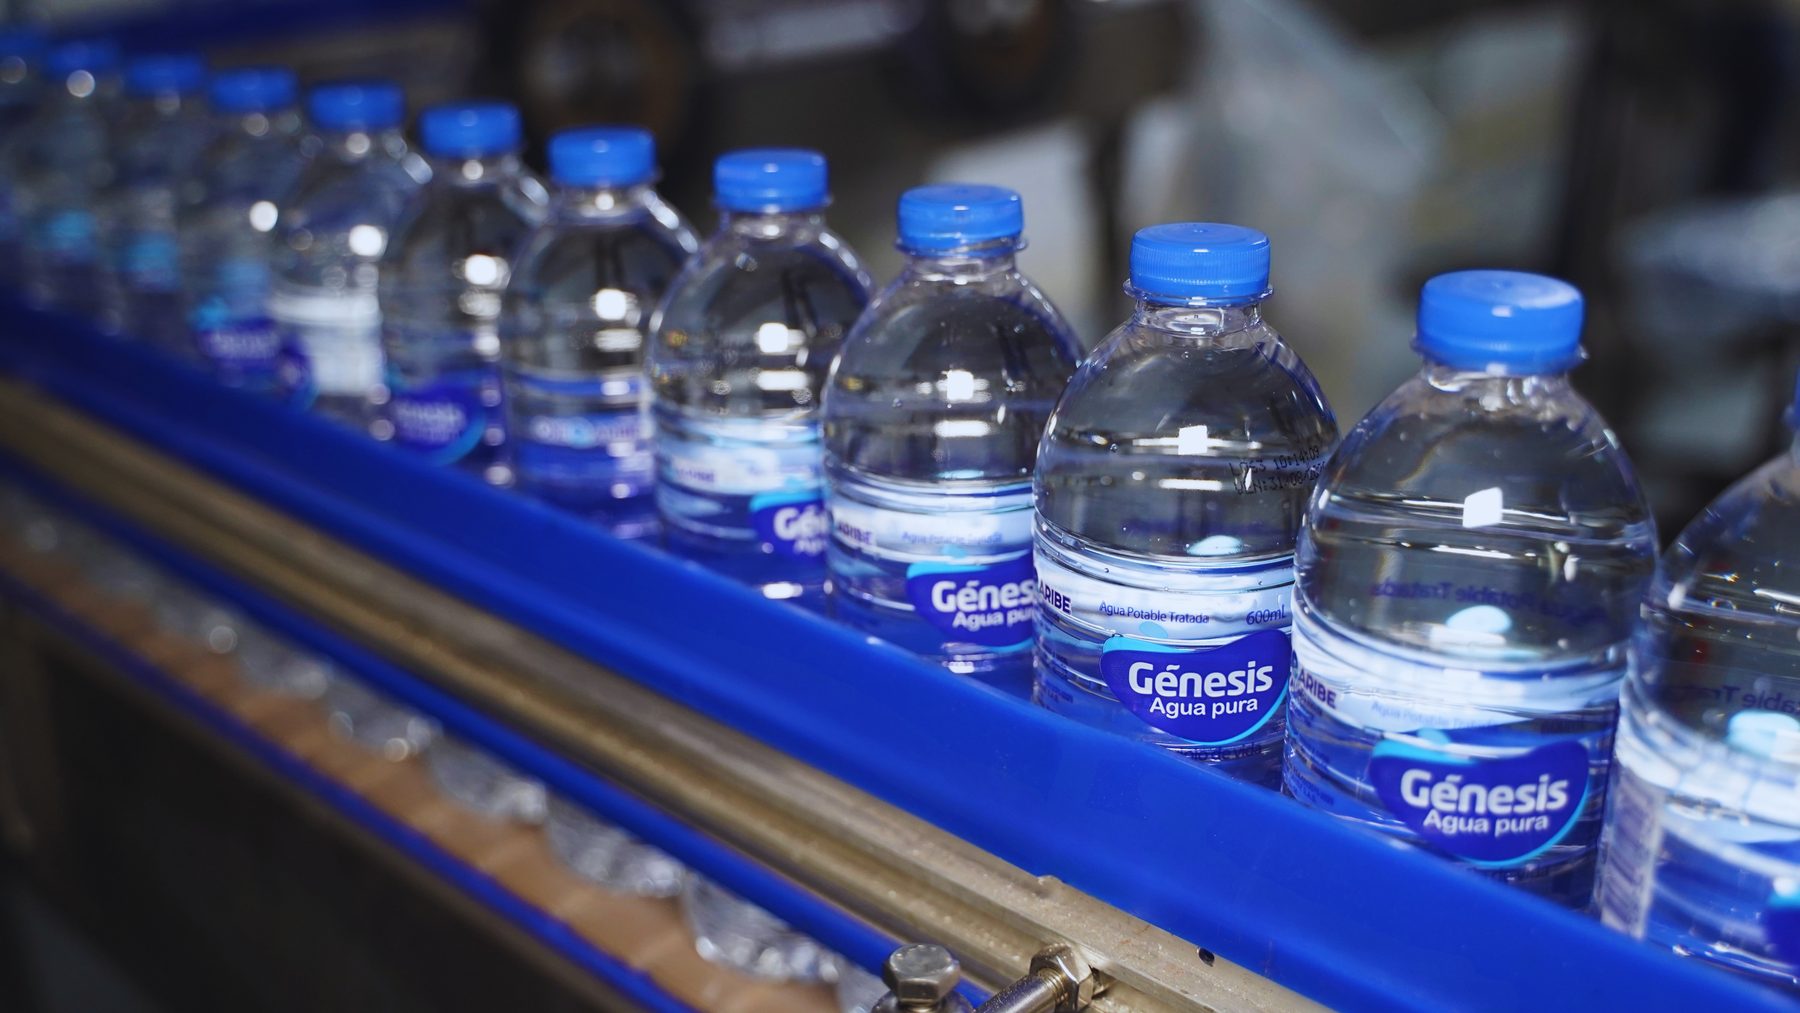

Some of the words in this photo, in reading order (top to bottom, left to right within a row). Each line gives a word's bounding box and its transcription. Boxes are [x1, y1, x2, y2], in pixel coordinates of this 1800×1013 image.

[952, 611, 1004, 631] Agua
[1099, 601, 1126, 617] Agua
[1127, 606, 1167, 622] Potable
[1169, 611, 1209, 623] Tratada
[1246, 604, 1286, 626] 600mL
[1128, 660, 1274, 698] Génesis
[1150, 697, 1206, 719] Agua
[1211, 698, 1259, 719] pura
[1400, 768, 1569, 815] Génesis
[1422, 808, 1489, 836] Agua
[1494, 815, 1549, 837] pura
